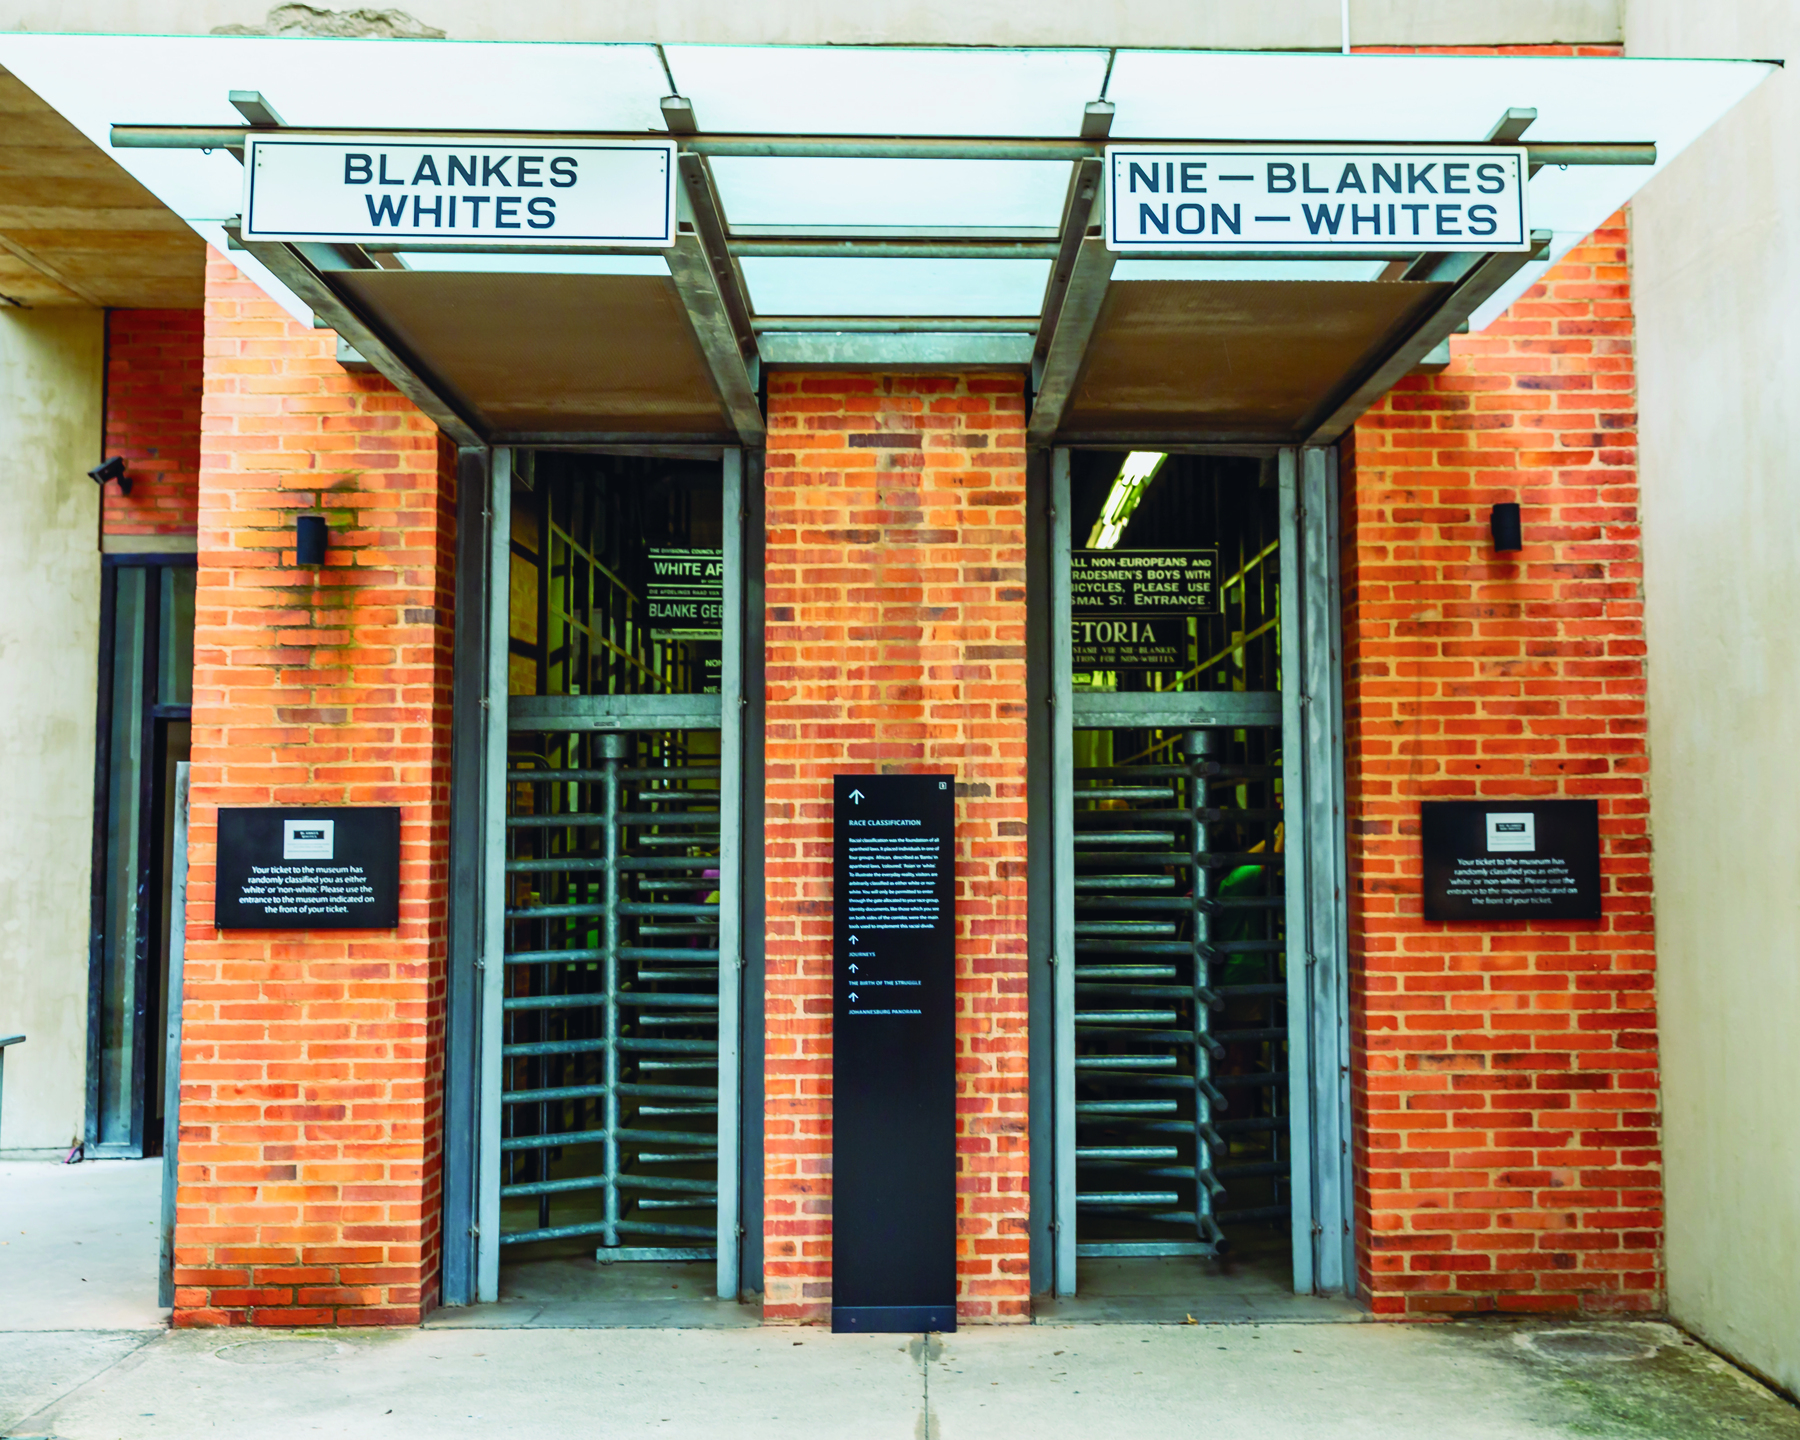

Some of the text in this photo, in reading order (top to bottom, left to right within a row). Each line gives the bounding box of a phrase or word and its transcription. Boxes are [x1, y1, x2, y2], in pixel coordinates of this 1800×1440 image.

[344, 153, 579, 188] BLANKES
[365, 194, 556, 229] WHITES
[1091, 558, 1187, 567] NON-EUROPEANS
[1192, 559, 1211, 567] AND
[654, 562, 702, 576] WHITE
[1072, 570, 1211, 580] RADESMEN'S BOYS WITH
[1133, 582, 1179, 592] PLEASE
[1187, 582, 1211, 592] USE
[649, 603, 698, 618] BLANKE
[252, 866, 269, 874] Your
[271, 866, 292, 874] ticket
[302, 866, 314, 874] the
[248, 876, 283, 885] randomly
[285, 876, 319, 884] classified
[320, 877, 334, 886] you
[273, 896, 281, 904] to
[282, 896, 294, 904] the
[330, 895, 363, 903] indicated
[265, 906, 278, 914] the
[279, 905, 298, 913] front
[299, 905, 308, 913] of
